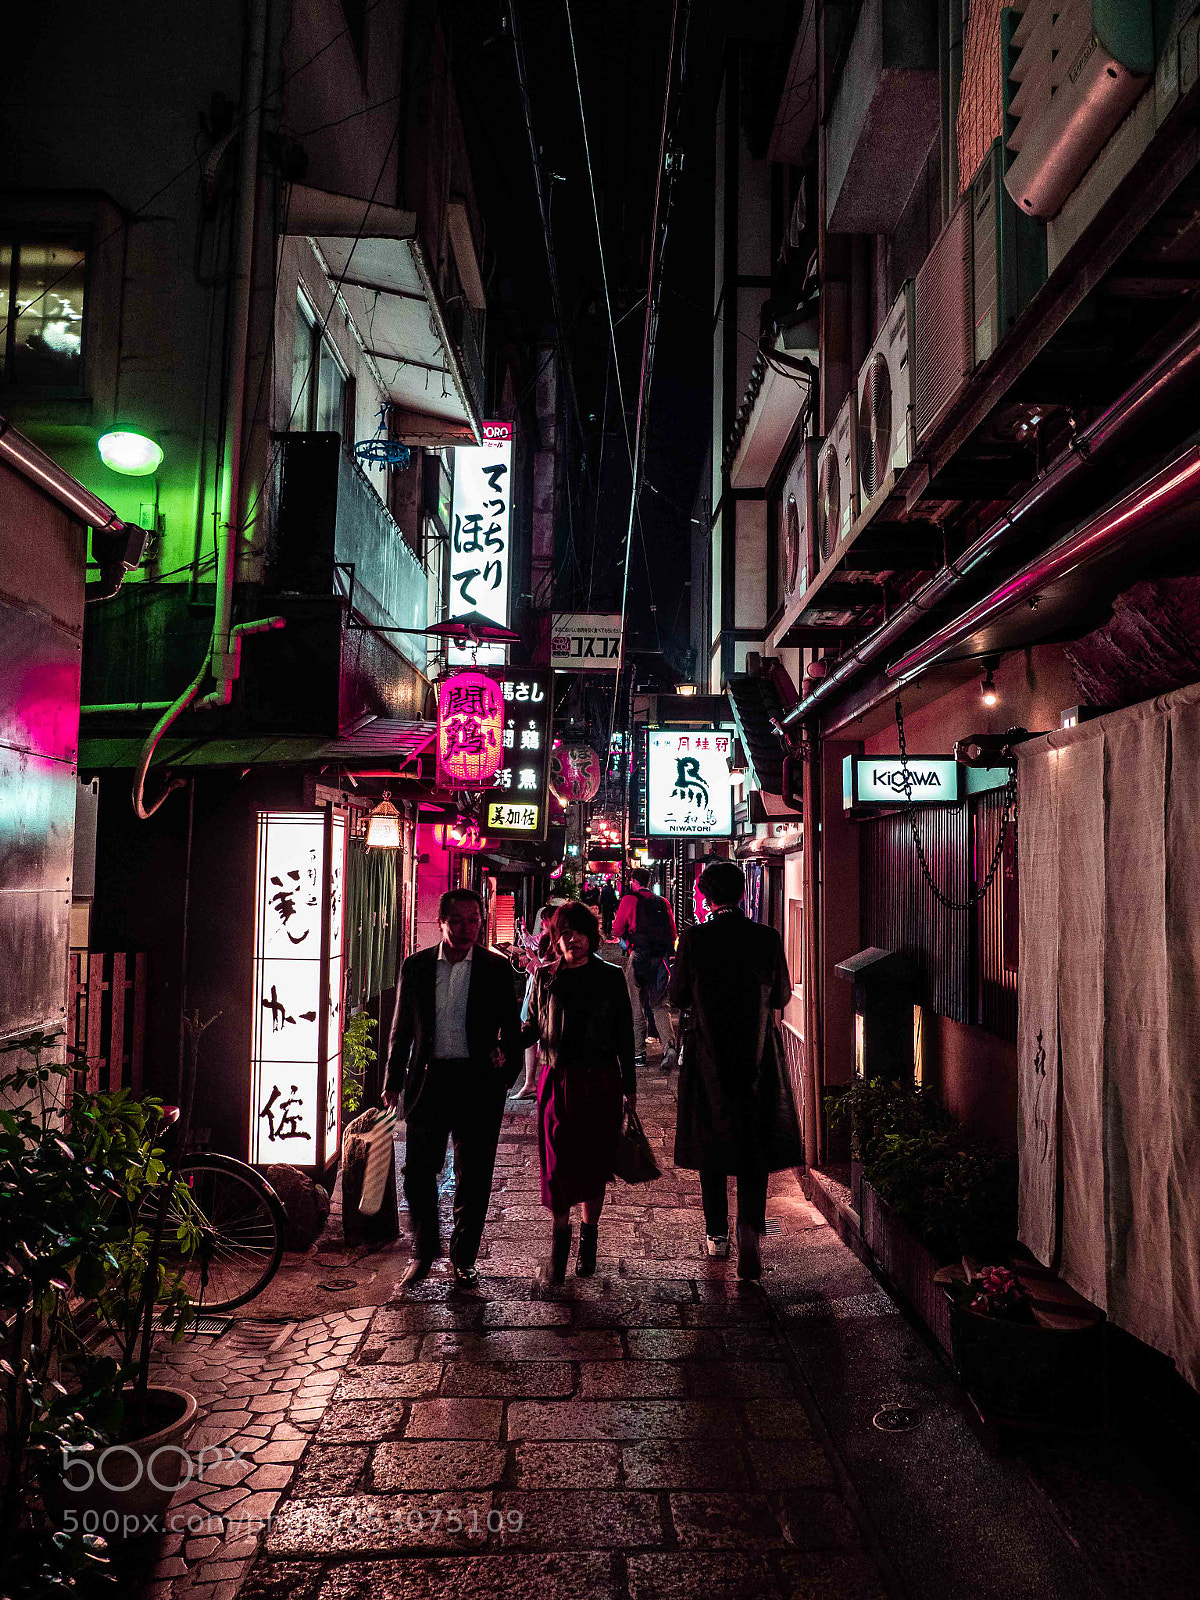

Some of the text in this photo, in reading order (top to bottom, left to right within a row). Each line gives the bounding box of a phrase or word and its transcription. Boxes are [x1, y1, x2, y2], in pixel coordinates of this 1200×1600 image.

[481, 463, 508, 591] てっちり
[570, 636, 621, 658] コスコス
[499, 682, 544, 702] 馬さし
[677, 736, 729, 753] 月桂冠
[492, 768, 538, 790] 活魚
[490, 806, 536, 826] 美加佐
